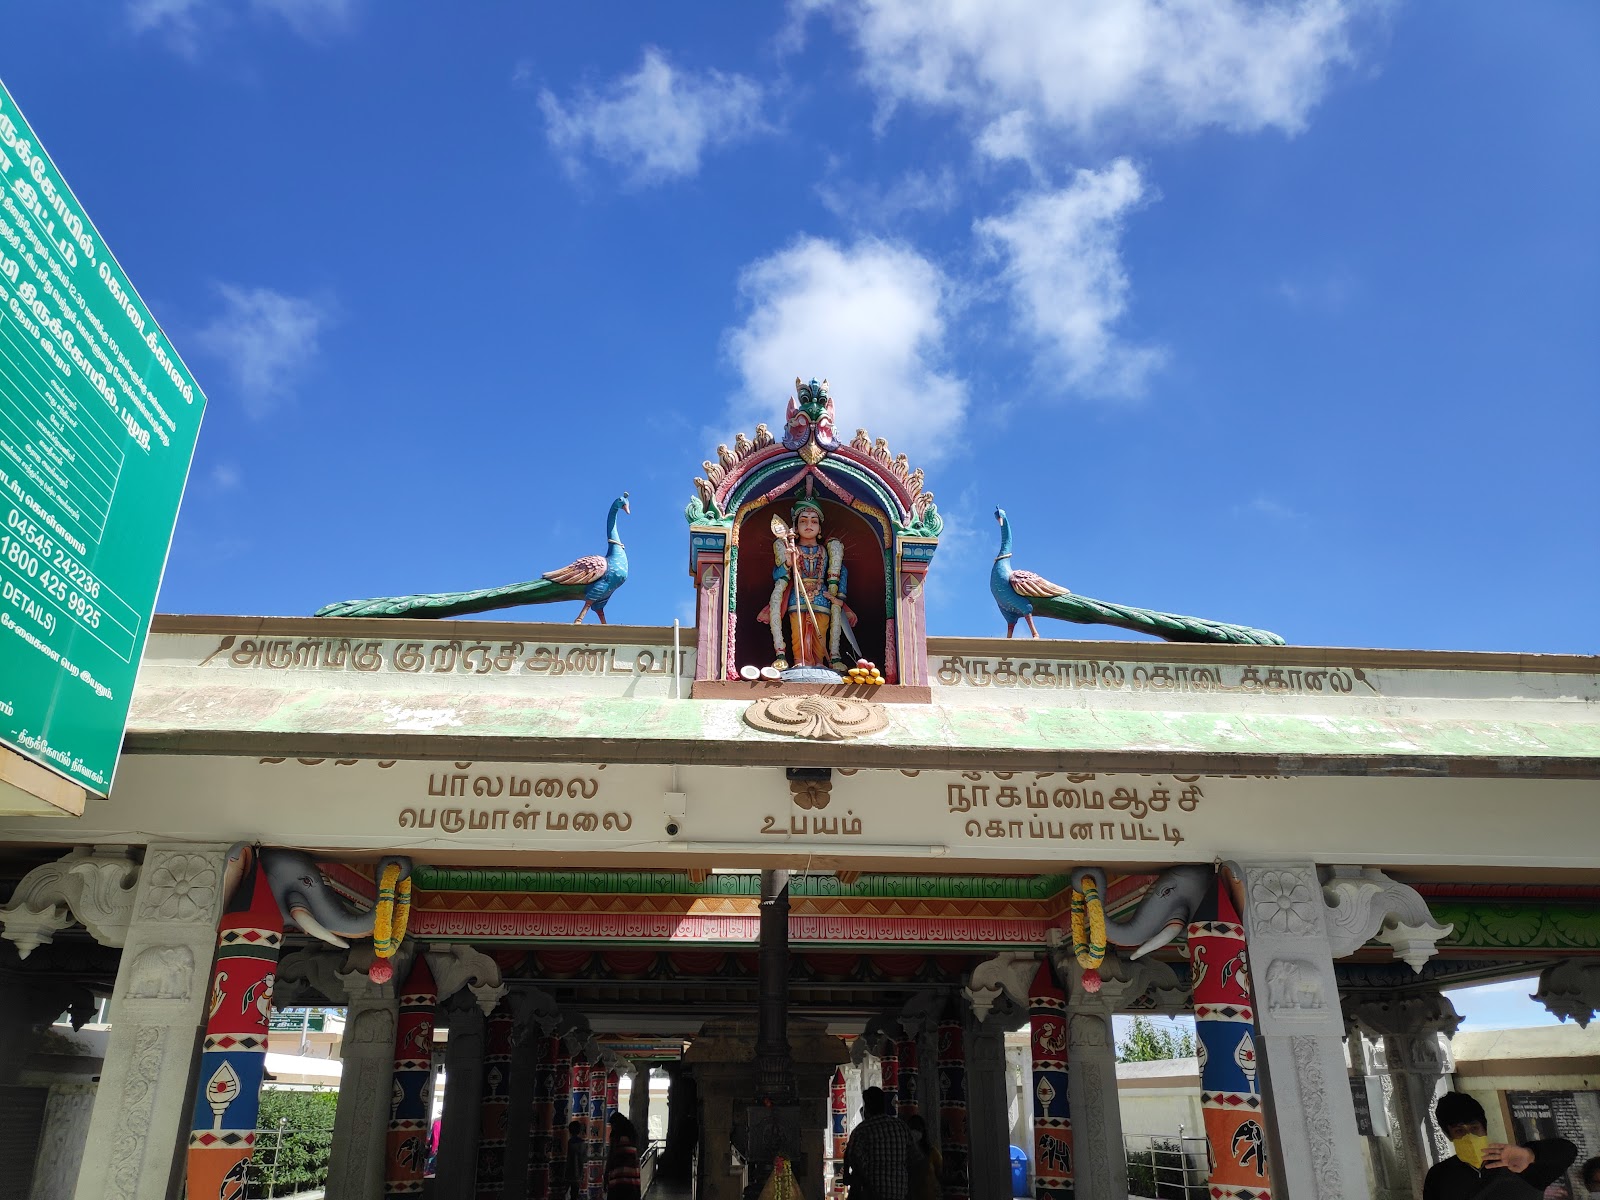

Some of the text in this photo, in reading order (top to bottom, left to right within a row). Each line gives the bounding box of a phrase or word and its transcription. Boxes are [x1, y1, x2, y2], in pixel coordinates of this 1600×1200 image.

[0, 98, 193, 404] ருக்கோயில், கொடைக்கானல்
[14, 178, 78, 268] திட்டம்
[18, 243, 38, 273] உரிய
[3, 197, 49, 260] தினந்தோறும்
[47, 256, 70, 289] மதியம்
[68, 283, 86, 310] 12.30
[84, 306, 109, 344] மணிக்கு
[107, 337, 120, 356] 100
[9, 298, 41, 340] நேரம்
[40, 338, 72, 377] விபரம்
[19, 282, 119, 413] திருக்கோயில்,
[8, 509, 101, 599] 04545 242236
[25, 495, 86, 556] கொள்ளலாம்
[1, 536, 101, 629] 1800 425 9925
[2, 582, 56, 636] DETAILS)
[0, 613, 113, 700] சேவைகளை பெற இயலும்.
[231, 636, 384, 672] அருள்மிகு
[392, 639, 525, 675] குறிஞ்சி
[936, 655, 1126, 688] திருக்கோயில்
[17, 729, 104, 784] திருக்கோயில் நிர்வாகம்
[759, 809, 864, 836] உபயம்
[963, 812, 1186, 847] கொப்பனாபட்டி
